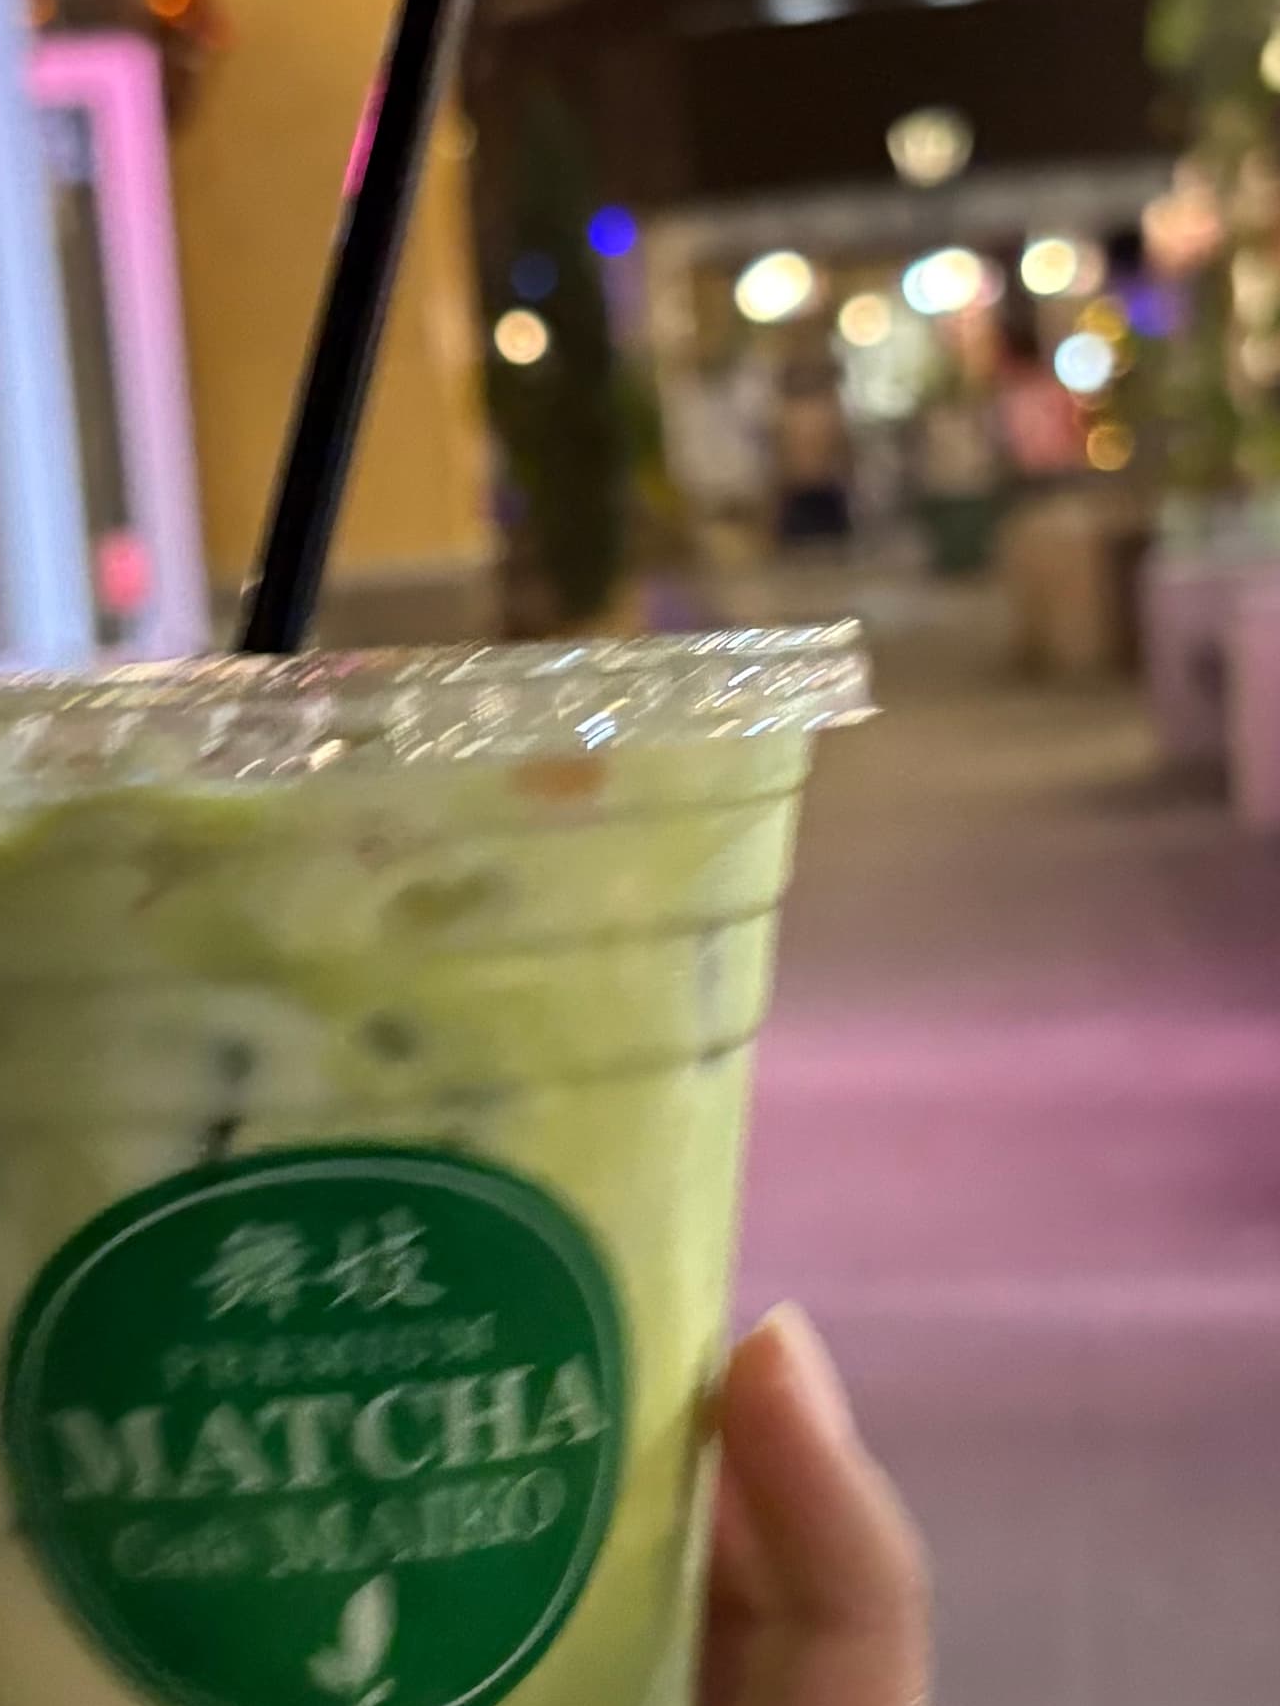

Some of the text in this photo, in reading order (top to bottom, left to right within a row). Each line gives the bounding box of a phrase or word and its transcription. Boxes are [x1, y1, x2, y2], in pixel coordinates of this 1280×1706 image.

[161, 1312, 494, 1390] PREMIUM
[50, 1353, 609, 1496] MATCHA
[265, 1467, 565, 1578] MAIKO
